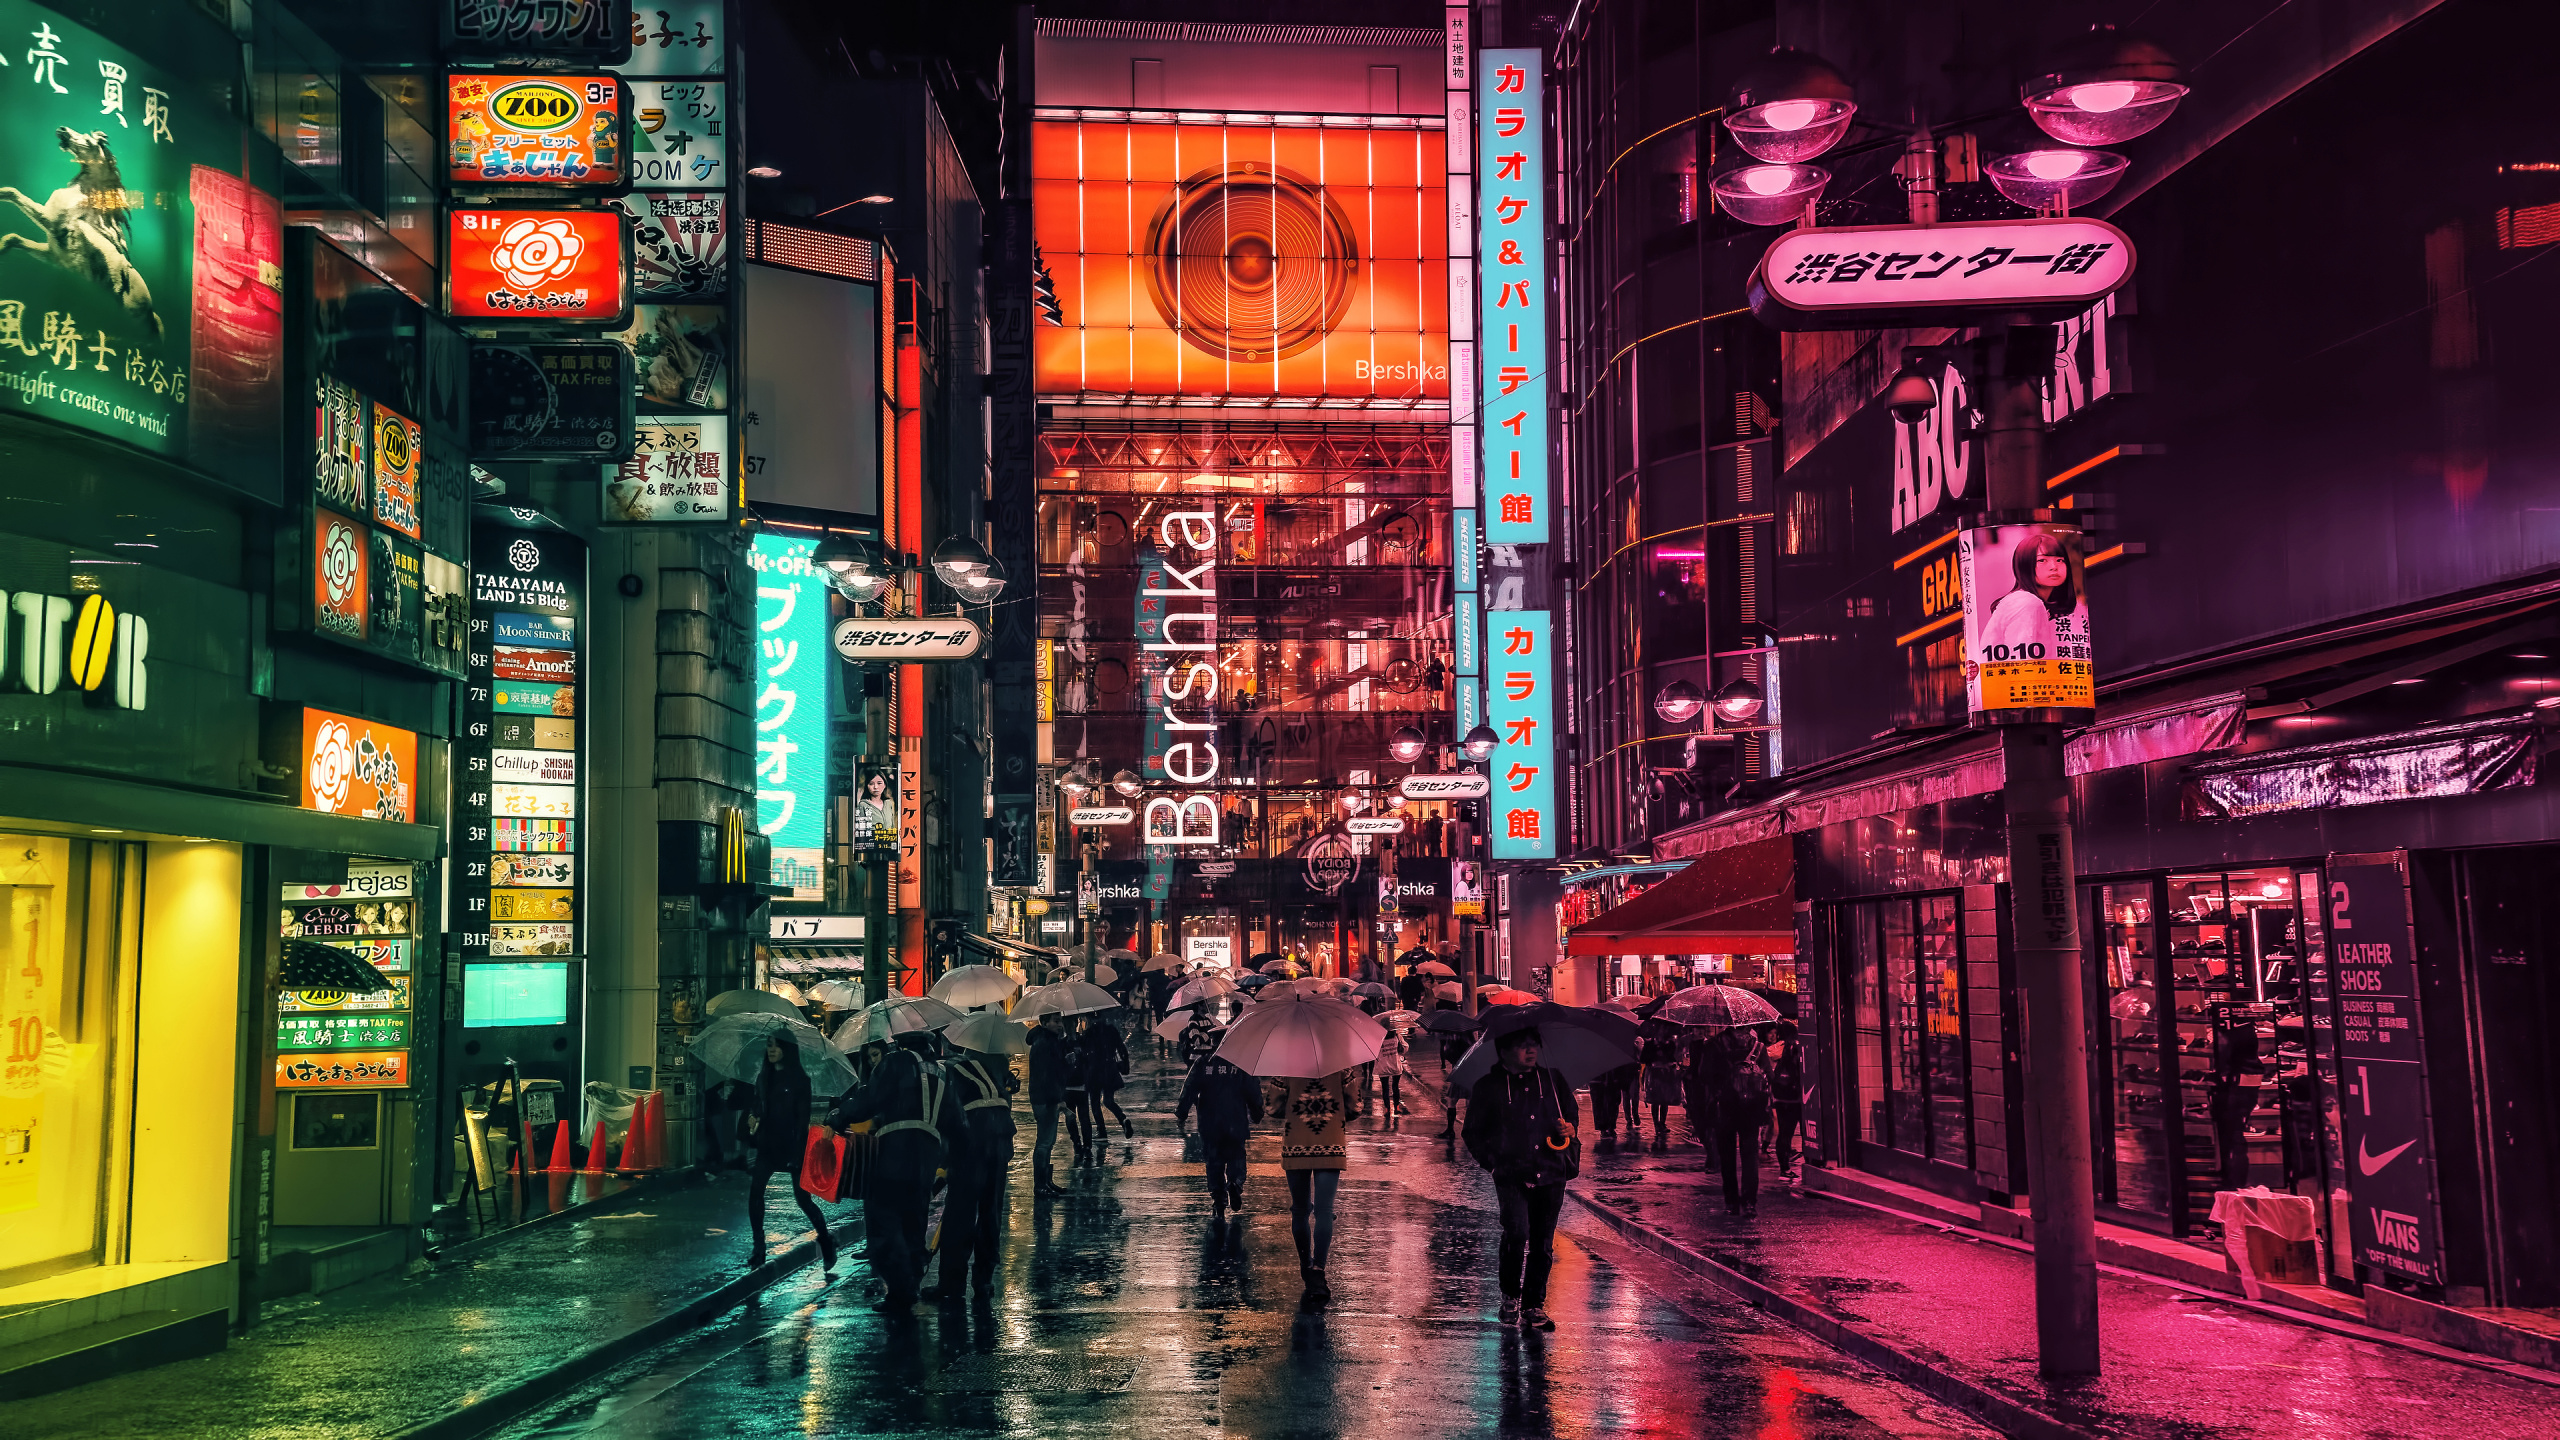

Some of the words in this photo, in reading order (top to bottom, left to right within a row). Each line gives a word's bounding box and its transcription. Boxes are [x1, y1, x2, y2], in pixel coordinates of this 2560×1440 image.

[1451, 18, 1465, 80] 林土地建物
[98, 58, 175, 144] 買取
[585, 82, 616, 105] 3F
[661, 85, 706, 102] ビック
[505, 97, 570, 117] ZOO
[688, 103, 716, 119] ワン
[493, 134, 537, 149] フリー
[538, 134, 580, 149] セット
[651, 199, 720, 216] 浜焼酒場
[679, 219, 720, 235] 渋谷店
[1784, 242, 2115, 285] 渋谷センター街
[486, 287, 585, 311] はなまるうどん
[542, 355, 613, 370] 高価買取
[1355, 359, 1447, 380] Bershka
[125, 348, 188, 404] 渋谷店
[551, 373, 579, 385] TAX
[584, 372, 612, 385] Free
[327, 381, 361, 421] カラオケ
[60, 388, 110, 416] creates
[113, 405, 136, 425] one
[138, 413, 170, 437] wind
[335, 412, 365, 450] ROOM
[635, 431, 700, 450] 天ぷら
[614, 452, 721, 483] 食べ放題
[659, 482, 719, 497] 飲み放題
[1460, 515, 1470, 585] SKECHERS
[476, 573, 566, 594] TAKAYAMA
[477, 588, 516, 603] LAND
[519, 593, 535, 605] 15
[538, 594, 570, 611] Bldg.
[471, 619, 489, 632] 9F
[1462, 599, 1472, 669] SKECHERS
[840, 630, 972, 646] 渋谷センター街
[0, 588, 149, 712] TOR
[1982, 642, 2046, 661] 10.10
[470, 653, 488, 667] 8F
[525, 657, 574, 674] AmorE
[1142, 510, 1220, 845] Bershka
[1986, 667, 2047, 677] 伝承ホール
[470, 687, 488, 701] 7F
[756, 582, 802, 836] ブックオフ
[469, 723, 488, 736] 6F
[1504, 626, 1541, 840] カラオケ館
[469, 758, 487, 770] 5F
[494, 755, 539, 774] Chillup
[544, 757, 574, 770] SHISHA
[540, 768, 574, 780] HOOKAH
[1407, 781, 1485, 793] 渋谷センター街
[468, 793, 487, 806] 4F
[505, 795, 572, 816] 花子っ子
[1072, 811, 1130, 821] 渋谷センター街
[468, 827, 487, 840] 3F
[1350, 820, 1400, 830] 渋谷センター街
[467, 863, 486, 876] 2F
[509, 862, 573, 883] トロハチ
[346, 870, 408, 896] rejas
[467, 898, 486, 911] 1F
[2331, 881, 2352, 929] 2
[304, 906, 350, 922] CLUB
[463, 933, 490, 946] B1F
[502, 928, 537, 941] 天ぷら
[1193, 940, 1228, 949] Bershka
[2338, 943, 2393, 966] LEATHER
[2341, 970, 2382, 992] SHOES
[2342, 1000, 2374, 1013] BUSINESS
[325, 1018, 369, 1028] 格安販売
[370, 1018, 385, 1028] TAX
[387, 1018, 404, 1027] Free
[2344, 1014, 2372, 1028] CASUAL
[6, 1015, 43, 1063] 10
[359, 1029, 402, 1042] 渋谷店
[2345, 1029, 2369, 1042] BOOTS
[286, 1059, 399, 1083] はなまるうどん
[2370, 1206, 2420, 1253] VANS
[2387, 1254, 2404, 1270] THE
